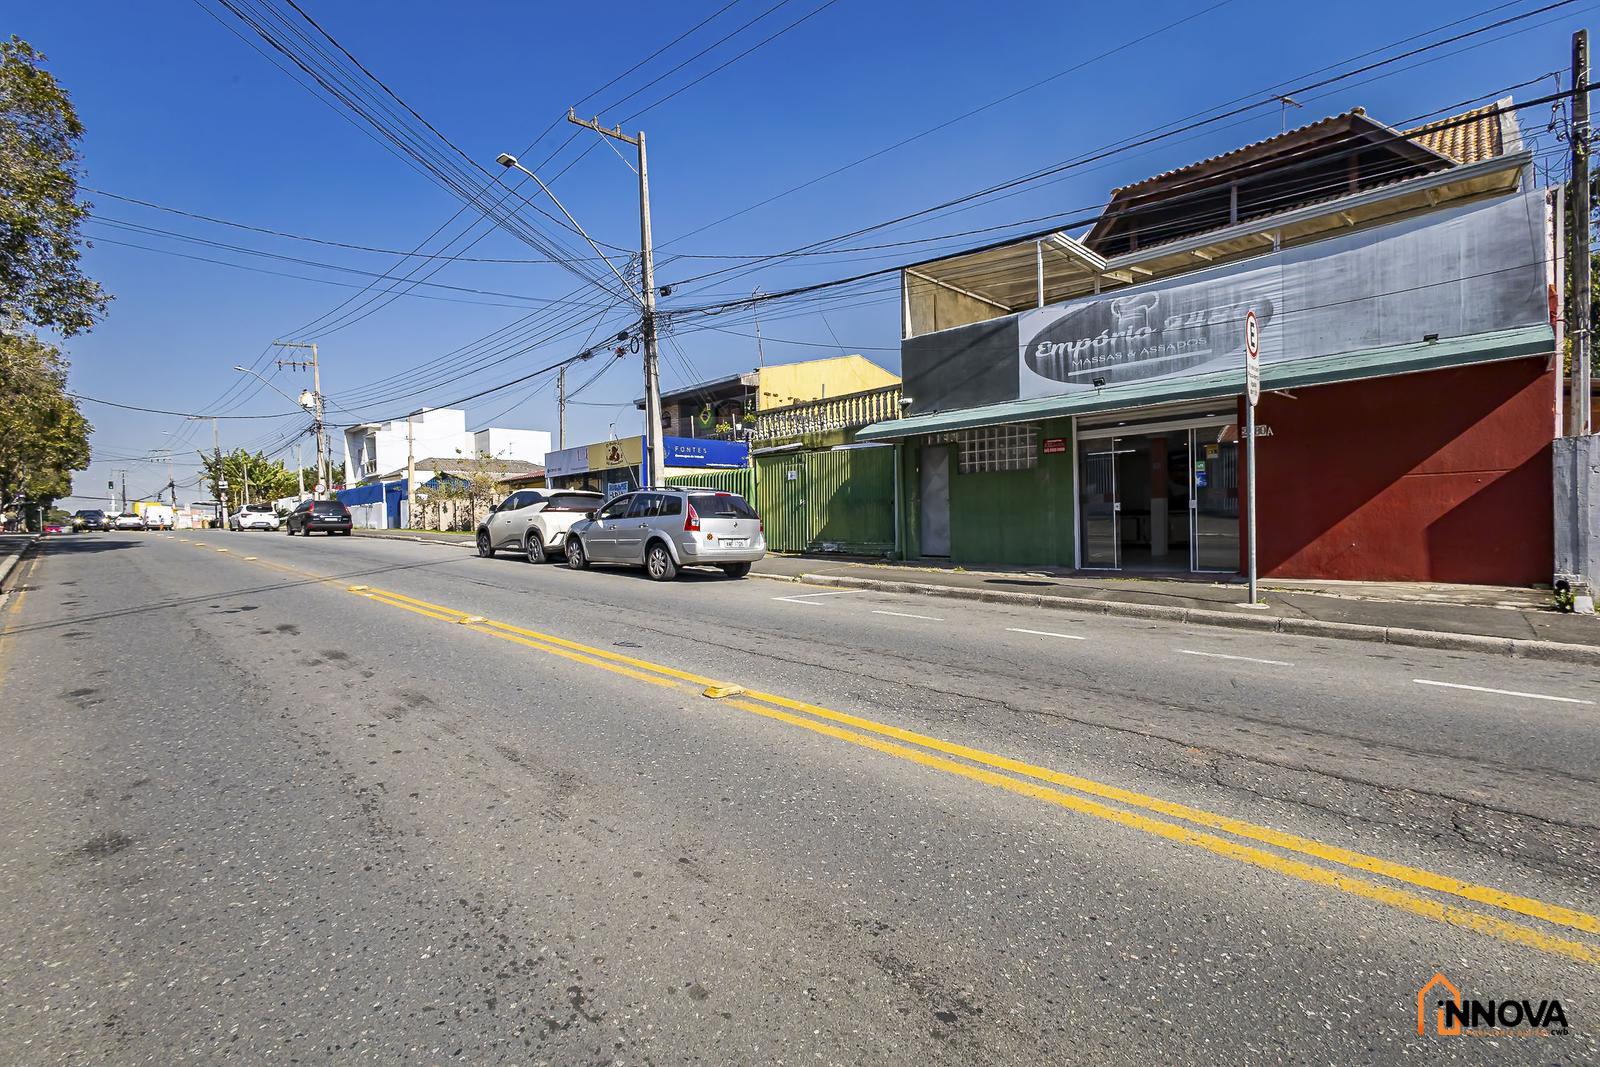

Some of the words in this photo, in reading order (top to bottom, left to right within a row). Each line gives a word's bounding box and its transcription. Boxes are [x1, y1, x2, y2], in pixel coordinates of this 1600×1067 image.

[1035, 325, 1157, 360] Empório
[1249, 321, 1256, 348] E
[1071, 352, 1123, 367] MASSAS
[1140, 337, 1208, 356] ASSADOS
[674, 446, 708, 454] FONTES
